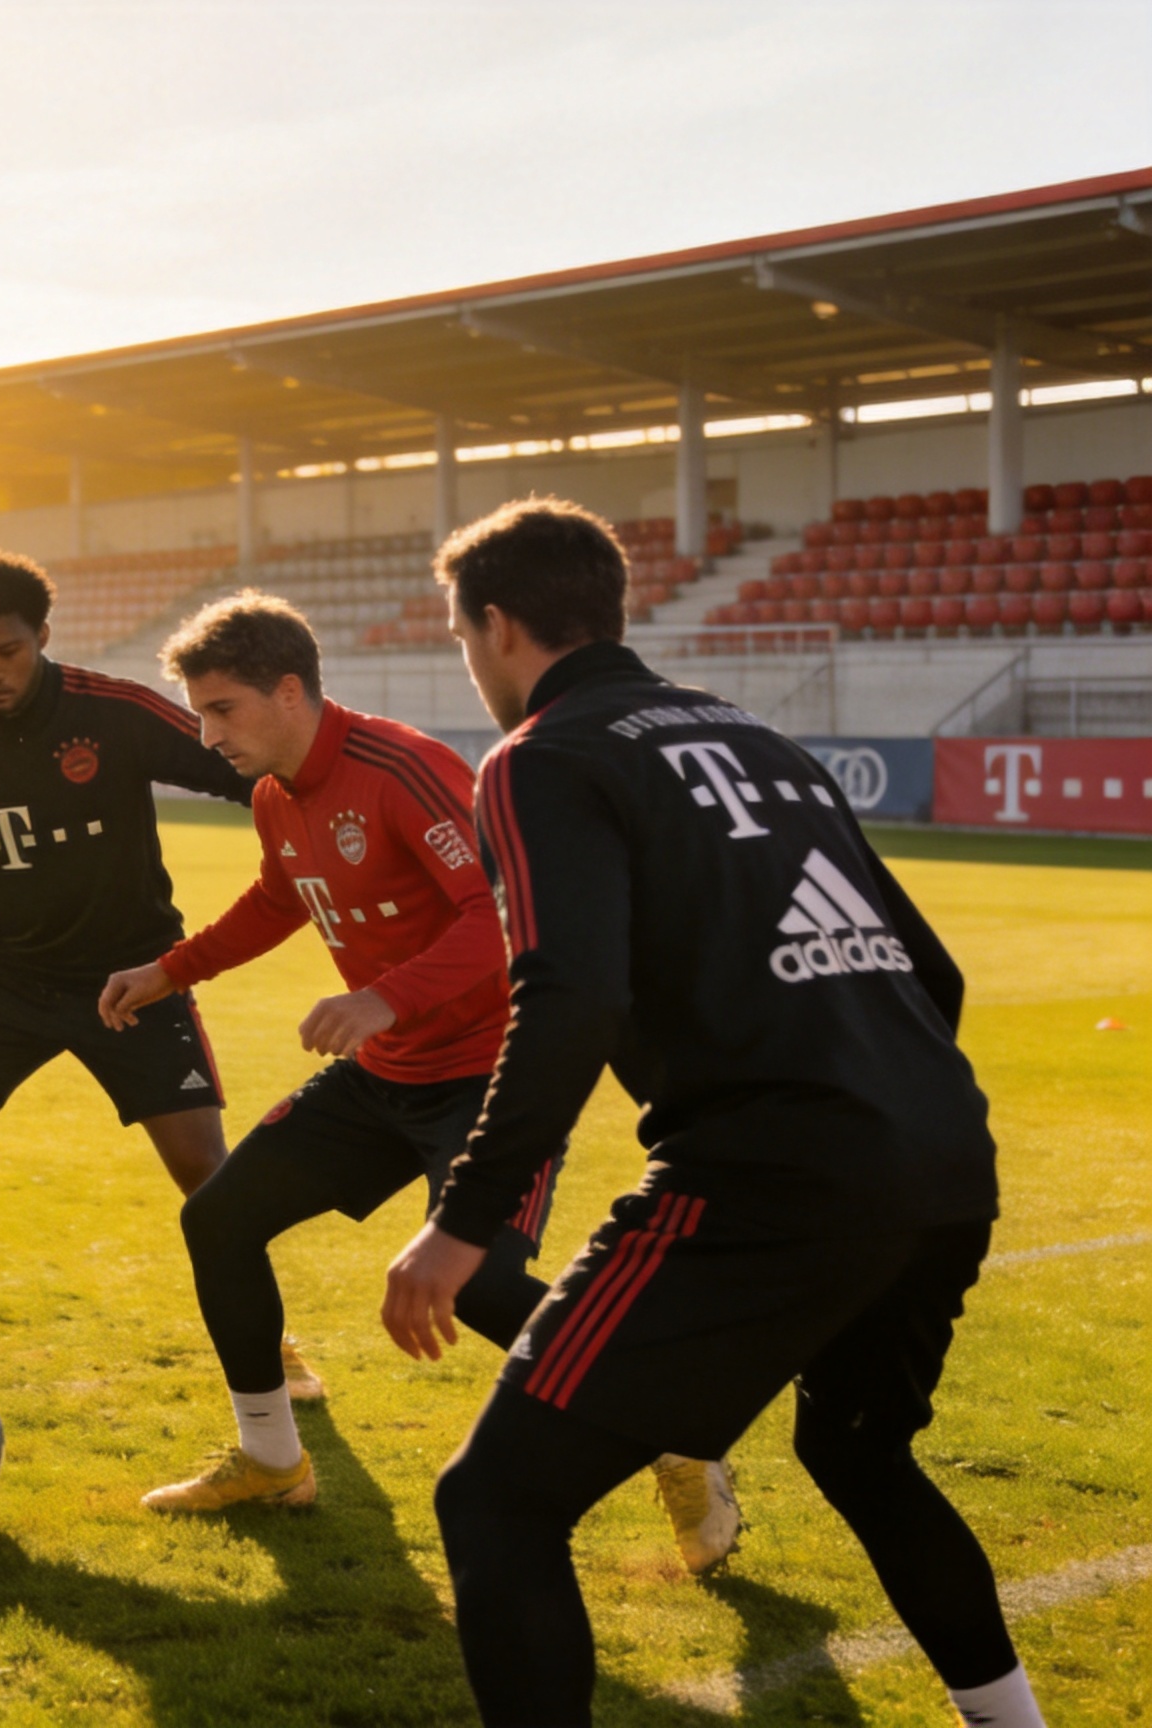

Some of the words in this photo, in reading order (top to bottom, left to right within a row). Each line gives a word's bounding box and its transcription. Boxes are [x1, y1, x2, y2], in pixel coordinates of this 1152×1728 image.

[659, 742, 769, 839] T
[984, 745, 1042, 822] T
[769, 928, 913, 983] adidas
